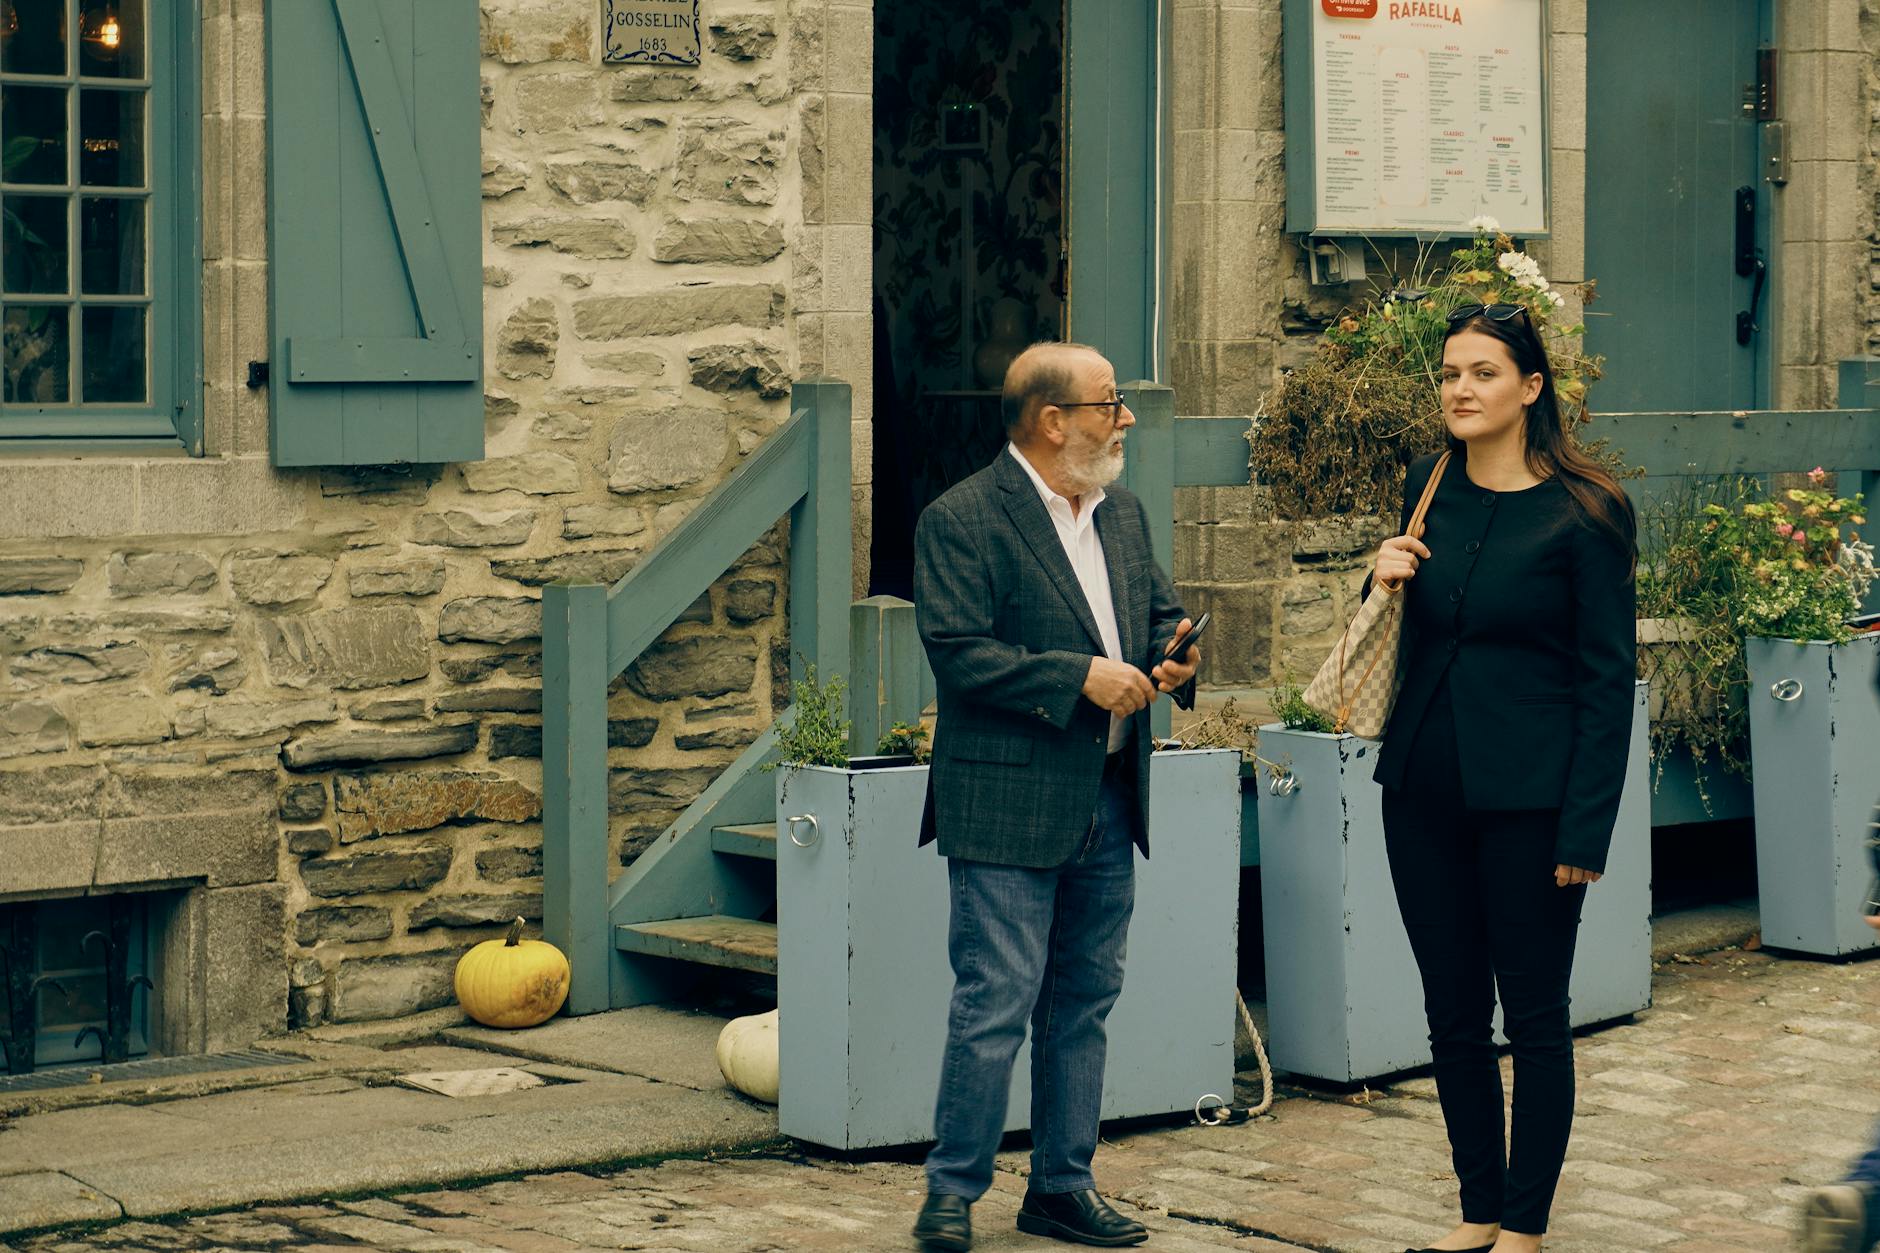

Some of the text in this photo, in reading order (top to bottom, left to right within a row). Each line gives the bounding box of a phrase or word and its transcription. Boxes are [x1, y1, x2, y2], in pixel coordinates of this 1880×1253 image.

[616, 12, 690, 28] GOSSELIN
[1389, 1, 1463, 25] RAFAELLA
[640, 38, 667, 51] 1683
